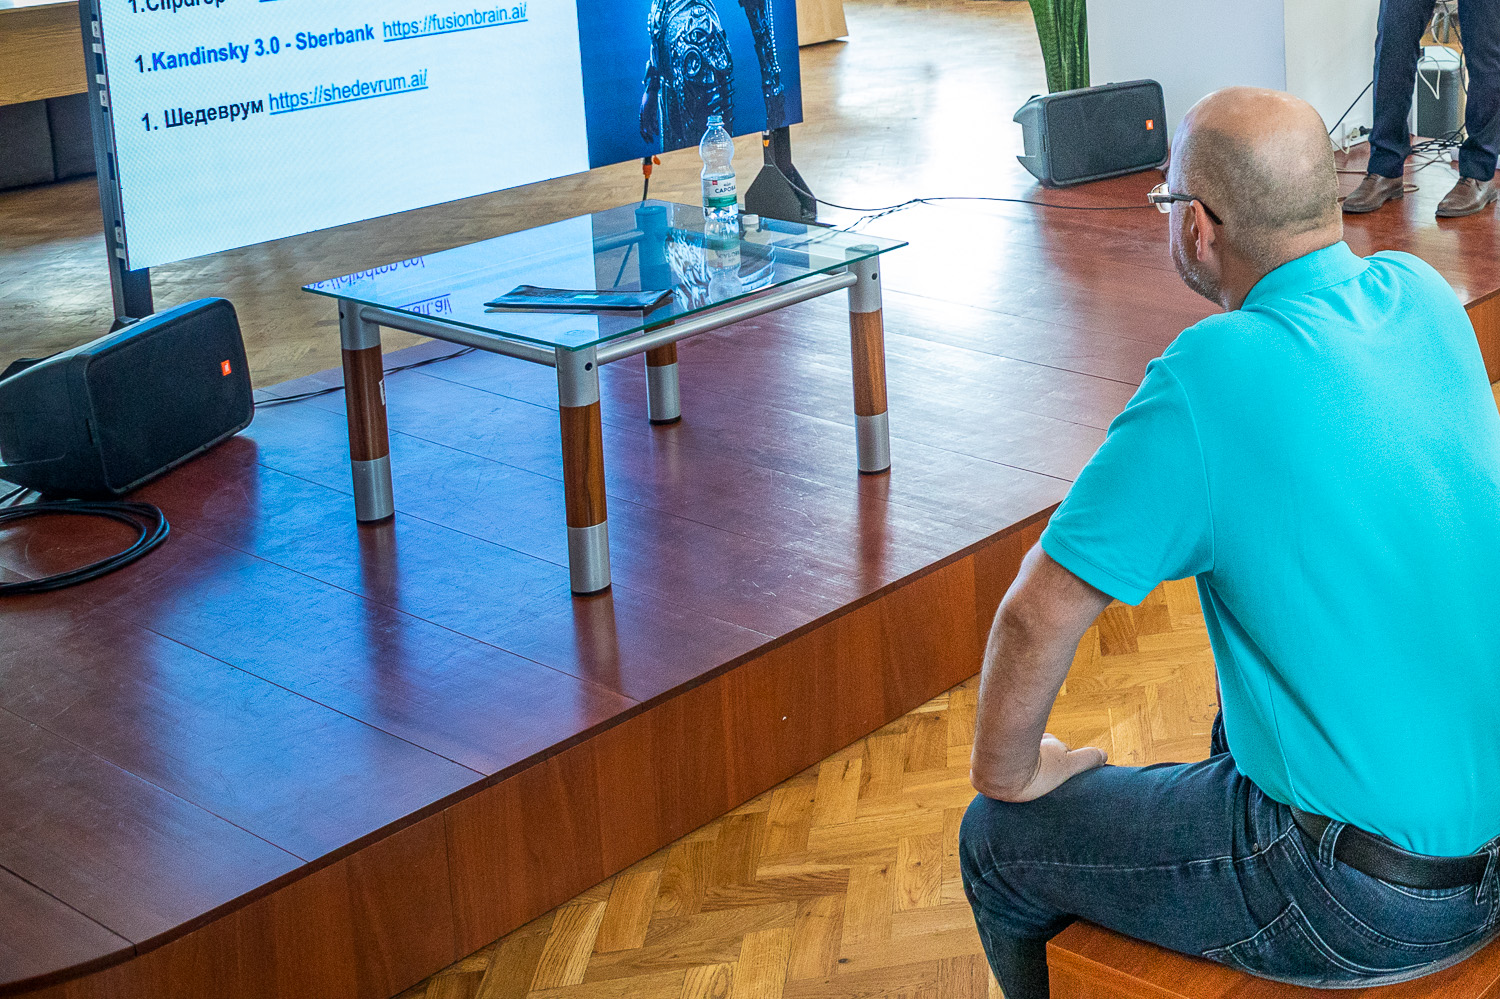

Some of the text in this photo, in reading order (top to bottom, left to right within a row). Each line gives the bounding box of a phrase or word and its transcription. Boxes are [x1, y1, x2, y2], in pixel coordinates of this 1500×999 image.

[254, 36, 280, 57] 3.0
[295, 23, 375, 51] Sberbank
[382, 2, 528, 42] https://fusionbrain.ai/
[141, 69, 429, 131] 1. Шедеврум https://shedevrum.ai/
